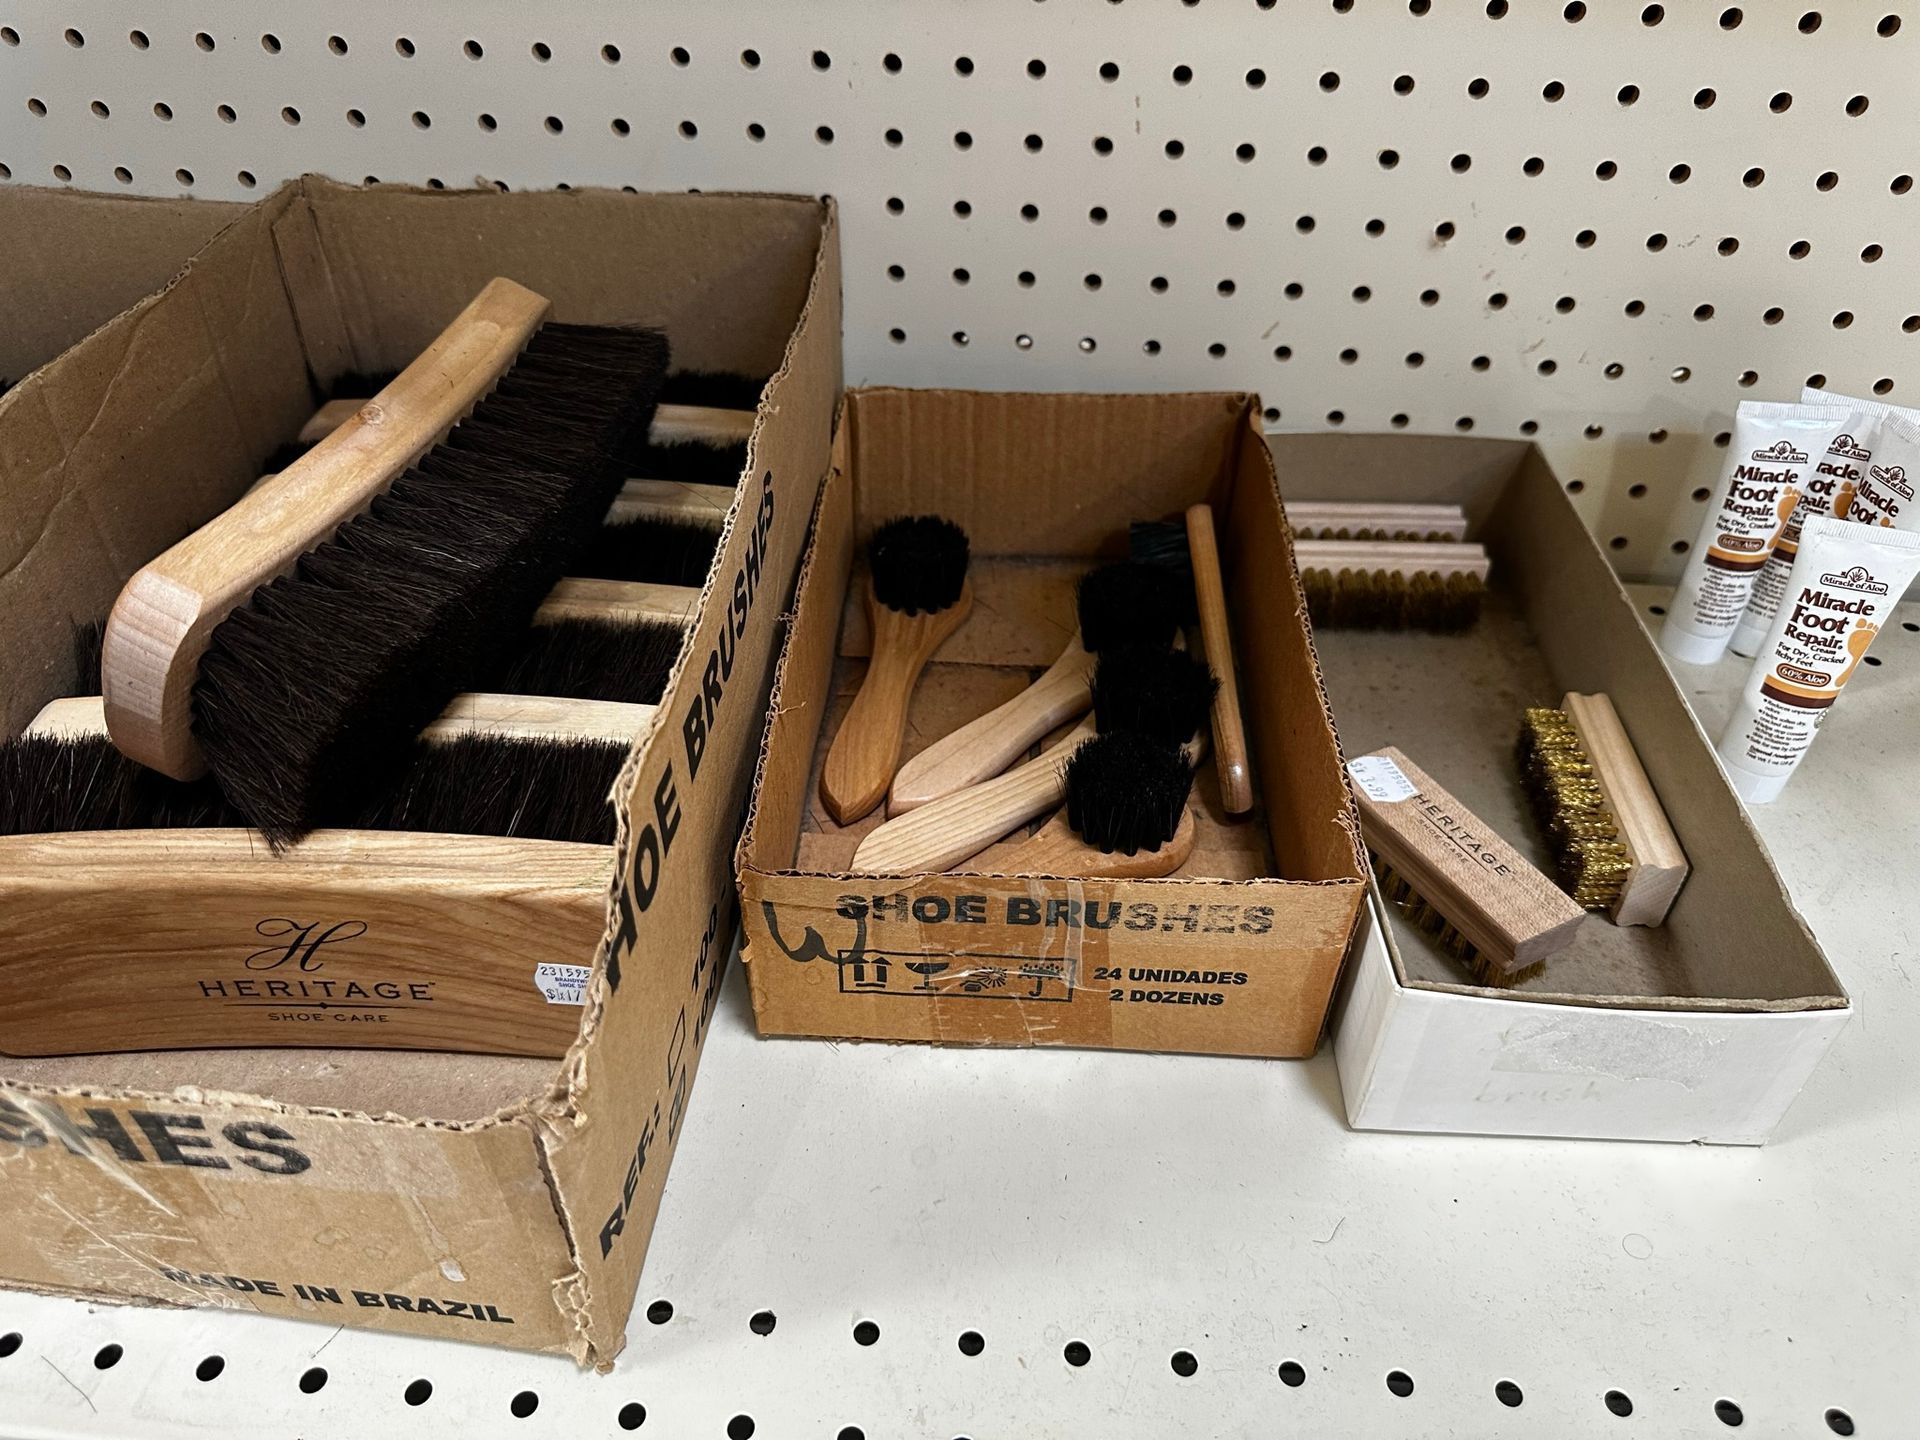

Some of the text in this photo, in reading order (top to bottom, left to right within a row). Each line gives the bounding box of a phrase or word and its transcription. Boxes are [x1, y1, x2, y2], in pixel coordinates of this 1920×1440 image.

[1733, 465, 1798, 483] Miracle
[1728, 480, 1778, 502] Foot
[1823, 576, 1854, 588] Miracle
[1865, 584, 1884, 593] Aloe
[1798, 588, 1875, 616] Miracle
[683, 470, 774, 783] BRUSHES
[1790, 604, 1850, 634] Foot
[1775, 649, 1813, 667] Itchy Feet
[1778, 641, 1846, 664] For Dry, Cracked
[1810, 645, 1836, 655] Cream
[1781, 667, 1826, 684] 60% Aloe
[1417, 818, 1469, 864] SHOE CARE
[836, 894, 1275, 935] SHOE BRUSHES
[691, 903, 717, 994] 100
[1093, 967, 1248, 984] 24 UNIDADES
[1109, 988, 1224, 1005] 2 DOZENS
[268, 1012, 389, 1023] SHOE CARE
[158, 1266, 515, 1324] MADE IN BRAZIL
